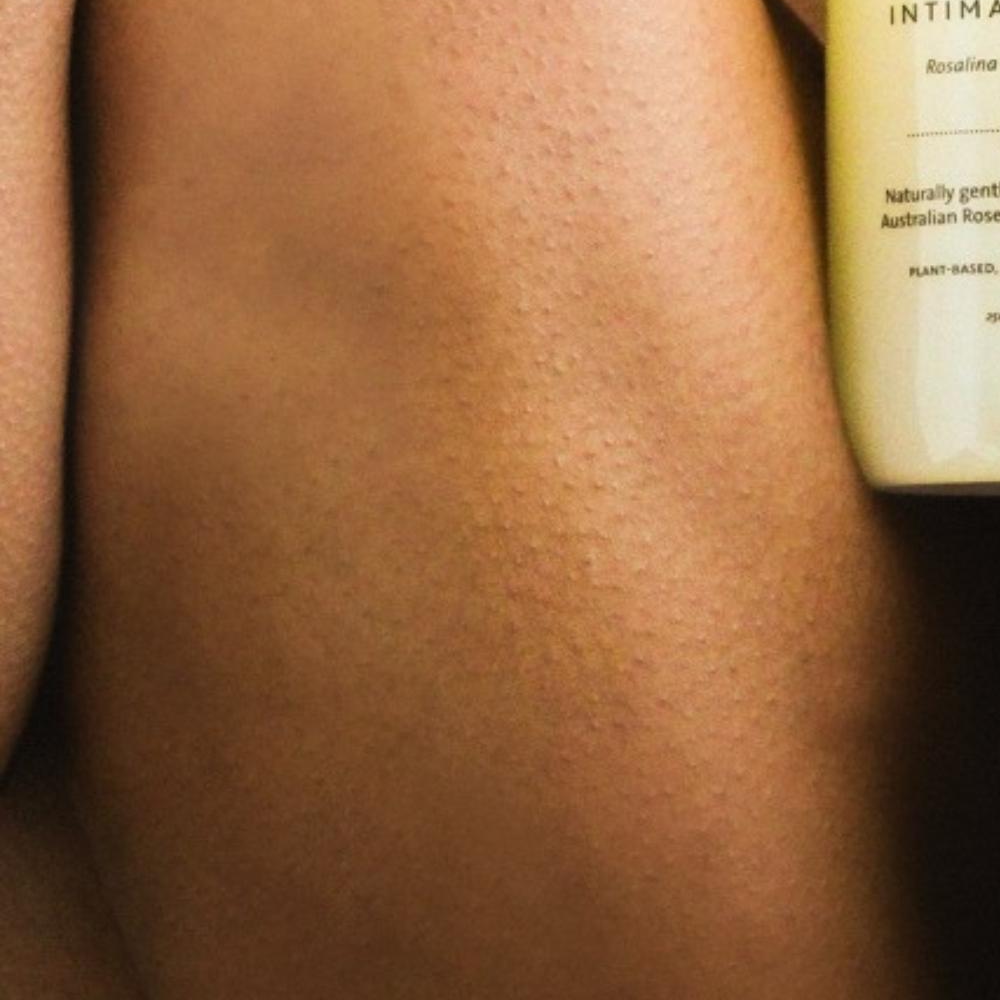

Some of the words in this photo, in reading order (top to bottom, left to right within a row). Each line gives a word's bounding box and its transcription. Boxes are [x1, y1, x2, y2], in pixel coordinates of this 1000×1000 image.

[926, 58, 998, 74] Rosalina
[885, 184, 955, 204] Naturally
[881, 207, 957, 229] Australian
[909, 264, 998, 278] PLANT-BASED,
